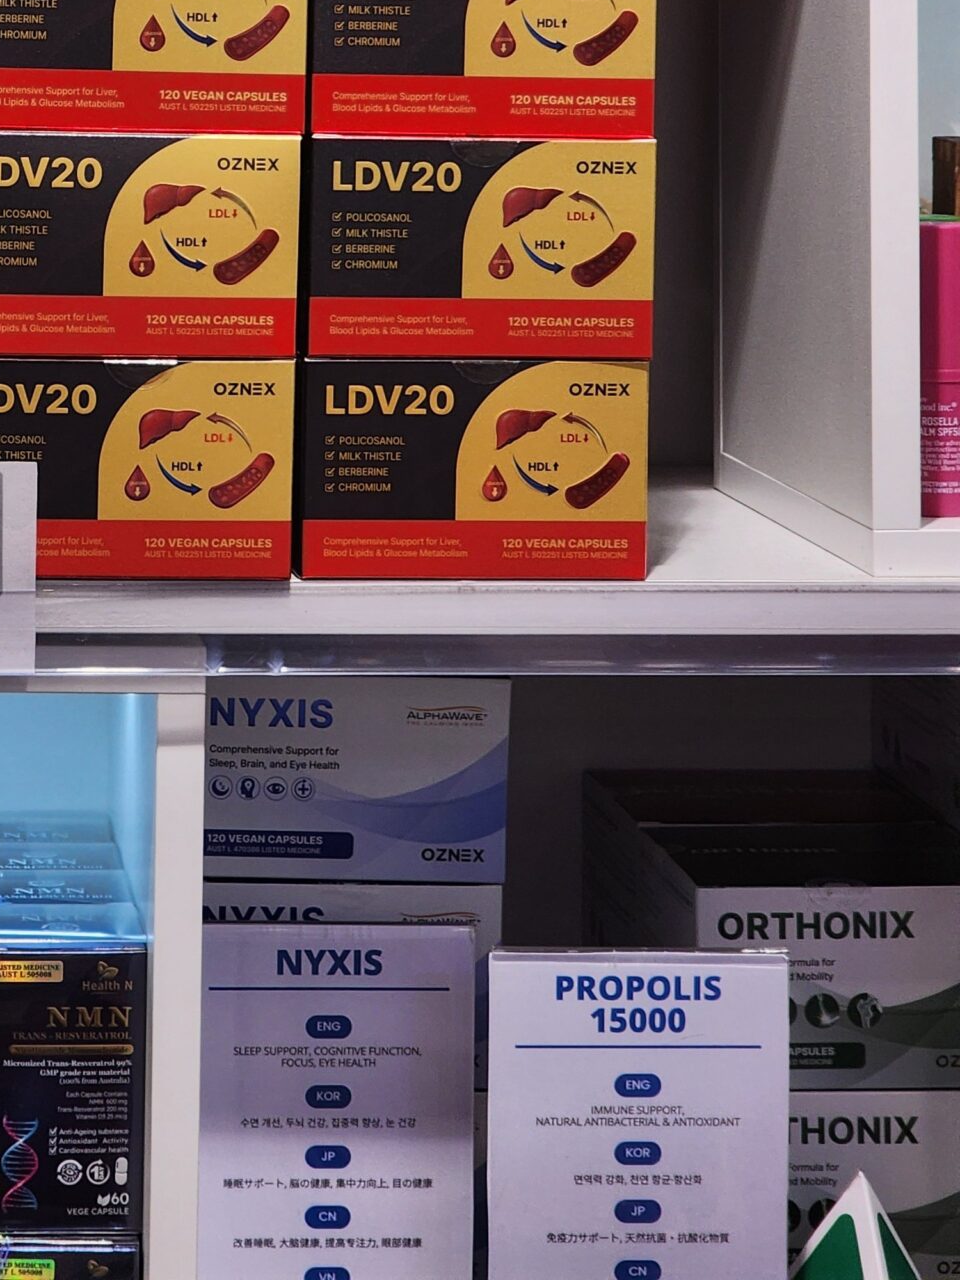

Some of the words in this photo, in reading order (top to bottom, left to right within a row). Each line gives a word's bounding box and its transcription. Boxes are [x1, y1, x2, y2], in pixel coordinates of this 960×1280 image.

[218, 158, 279, 171] OZNEX
[326, 385, 454, 415] LDV20
[210, 698, 333, 729] NYXIS
[209, 744, 285, 756] Comprehensive
[286, 746, 324, 758] Support
[325, 747, 339, 757] for
[209, 758, 238, 769] Sleep,
[241, 759, 267, 770] Brain,
[270, 760, 287, 769] and
[290, 760, 307, 771] Eye
[309, 760, 340, 770] Health
[207, 833, 227, 844] 120
[229, 834, 266, 844] VEGAN
[268, 834, 323, 845] CAPSULES
[422, 848, 484, 862] OZNEX
[718, 911, 914, 940] ORTHONIX
[278, 948, 382, 976] NYXIS
[557, 976, 721, 1001] PROPOLIS
[317, 1022, 341, 1031] ENG
[592, 1008, 686, 1033] 15000
[233, 1046, 262, 1057] SLEEP
[263, 1046, 312, 1058] SUPPORT,
[313, 1046, 367, 1057] COGNITIVE
[368, 1046, 422, 1058] FUNCTION,
[281, 1058, 316, 1069] FOCUS,
[318, 1058, 338, 1068] EYE
[338, 1058, 377, 1068] HEALTH
[624, 1080, 651, 1090] ENG
[317, 1092, 340, 1101] KOR
[590, 1106, 635, 1116] IMMUNE
[636, 1106, 685, 1117] SUPPORT,
[536, 1117, 582, 1127] NATURAL
[584, 1116, 660, 1127] ANTIBACTERIAL
[662, 1118, 670, 1126] &
[672, 1118, 740, 1127] ANTIOXIDANT
[322, 1152, 335, 1161] JP
[624, 1148, 650, 1158] KOR
[319, 1212, 337, 1221] CN
[631, 1206, 646, 1216] JP
[629, 1266, 647, 1276] CN
